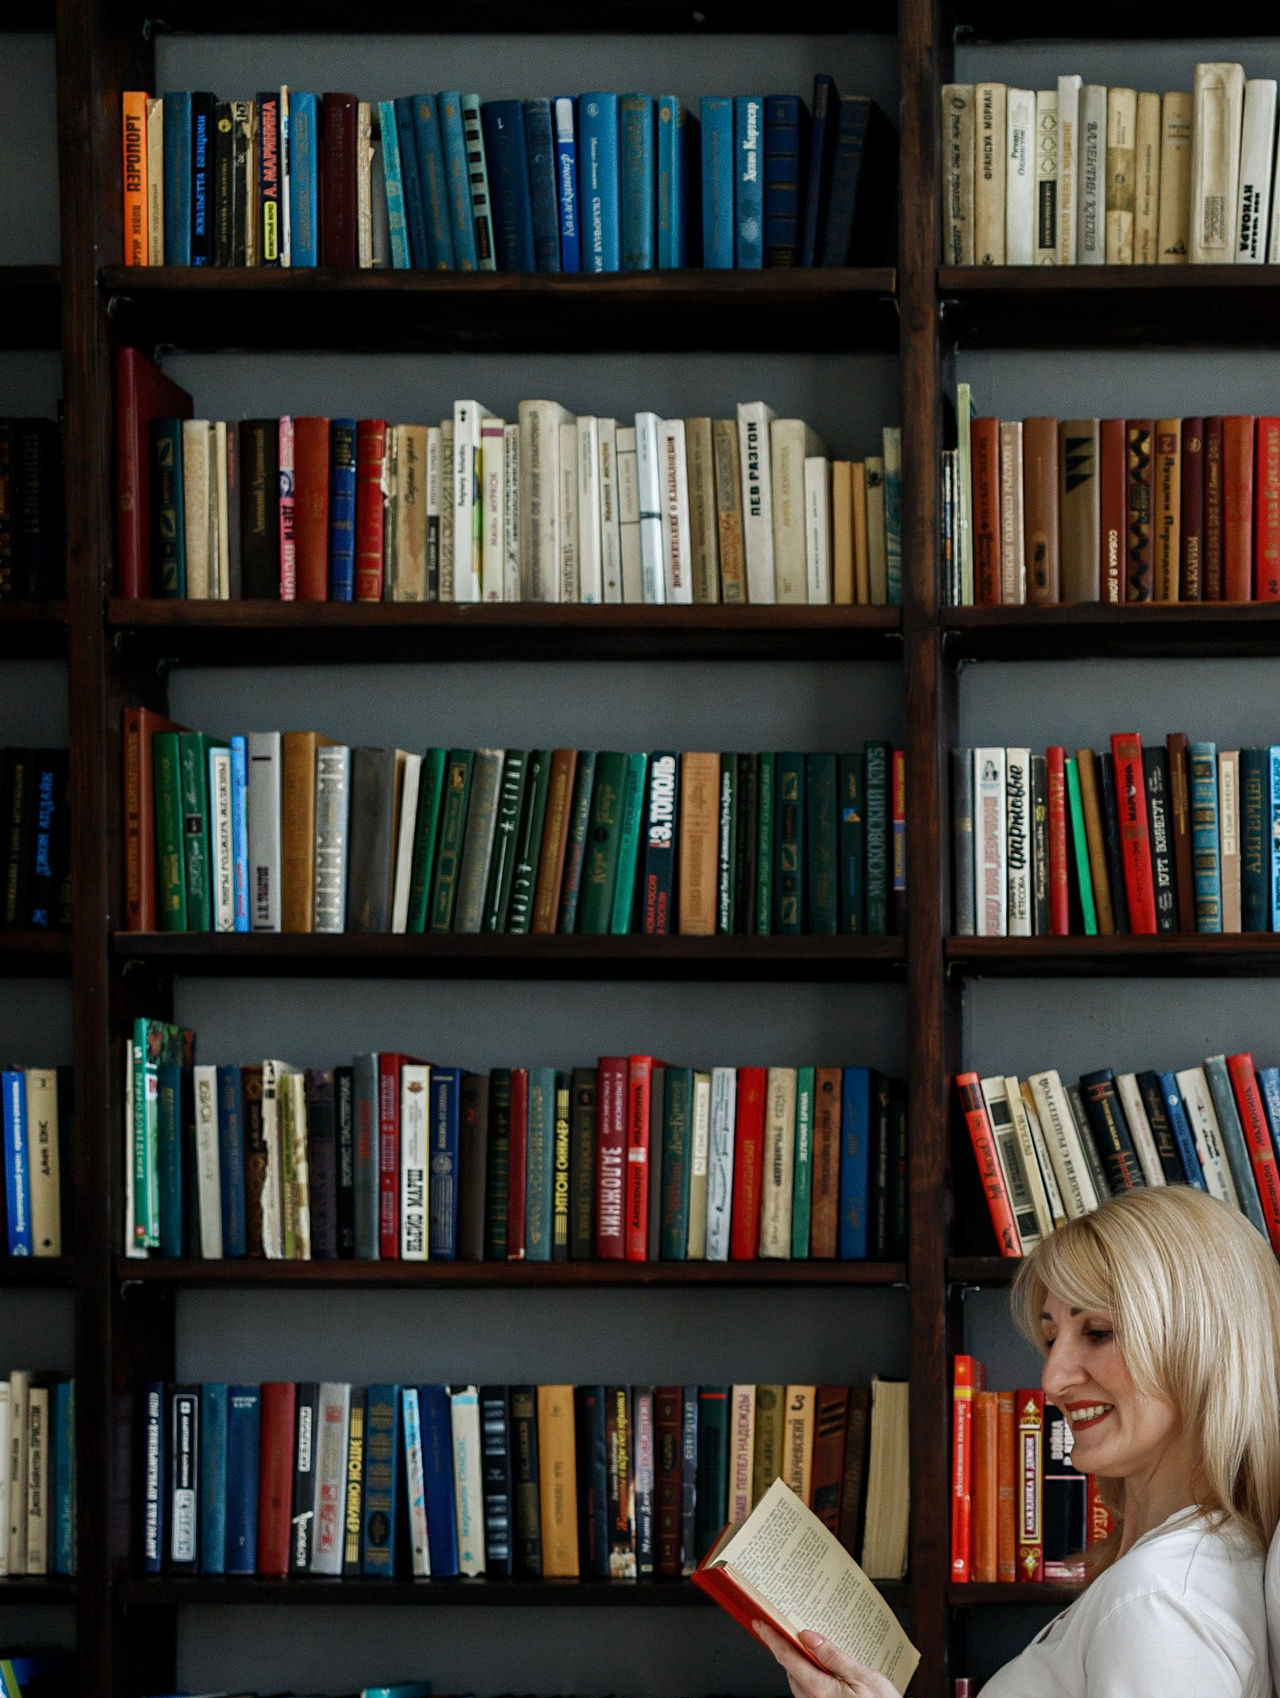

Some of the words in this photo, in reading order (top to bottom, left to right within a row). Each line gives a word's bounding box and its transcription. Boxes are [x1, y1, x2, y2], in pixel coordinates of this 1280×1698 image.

[262, 101, 277, 181] МАРИНИНА
[743, 102, 758, 149] Кортасар
[126, 115, 142, 192] АЭРОПОРТ
[743, 151, 757, 181] Хулио
[983, 134, 993, 180] ФРАНСУА
[1084, 122, 1098, 194] ВАЛЕНТИН
[265, 184, 277, 197] А.
[746, 422, 760, 480] РАЗГОН
[1109, 530, 1118, 568] СОБАКА
[868, 747, 886, 785] КЛУБ
[868, 788, 886, 897] МОСКОВСКИЙ
[1007, 765, 1026, 870] Фартовые
[1153, 798, 1168, 853] ВОННЕГУТ
[219, 820, 228, 871] РОДЖЕРА
[220, 873, 229, 906] МИРЫ
[1157, 858, 1170, 886] КУРТ
[1019, 876, 1027, 920] НЕТЕСОВА
[341, 1076, 353, 1144] ПАСТЕРНАК
[633, 1084, 644, 1147] МАРИНИНА
[1041, 1077, 1069, 1149] РЕЦЕПТУРОЙ
[1244, 1086, 1264, 1148] МАРИНИНА
[341, 1146, 353, 1187] БОРИС
[556, 1119, 569, 1170] СИНКЛЕР
[406, 1169, 423, 1208] МАРШ
[556, 1173, 569, 1215] ЭПТОН
[601, 1146, 622, 1237] ЗАЛОЖНИК
[632, 1166, 643, 1229] Александра
[735, 1394, 752, 1451] НАДЕЖДЫ
[1049, 1420, 1064, 1461] ВОЙНА
[348, 1439, 363, 1481] ЭПТОН
[733, 1453, 748, 1491] ПЕПЕЛ
[1025, 1437, 1037, 1470] ДЕМОН
[347, 1482, 362, 1533] СИНКЛЕР
[1025, 1480, 1036, 1532] АНЖЕЛИКА
